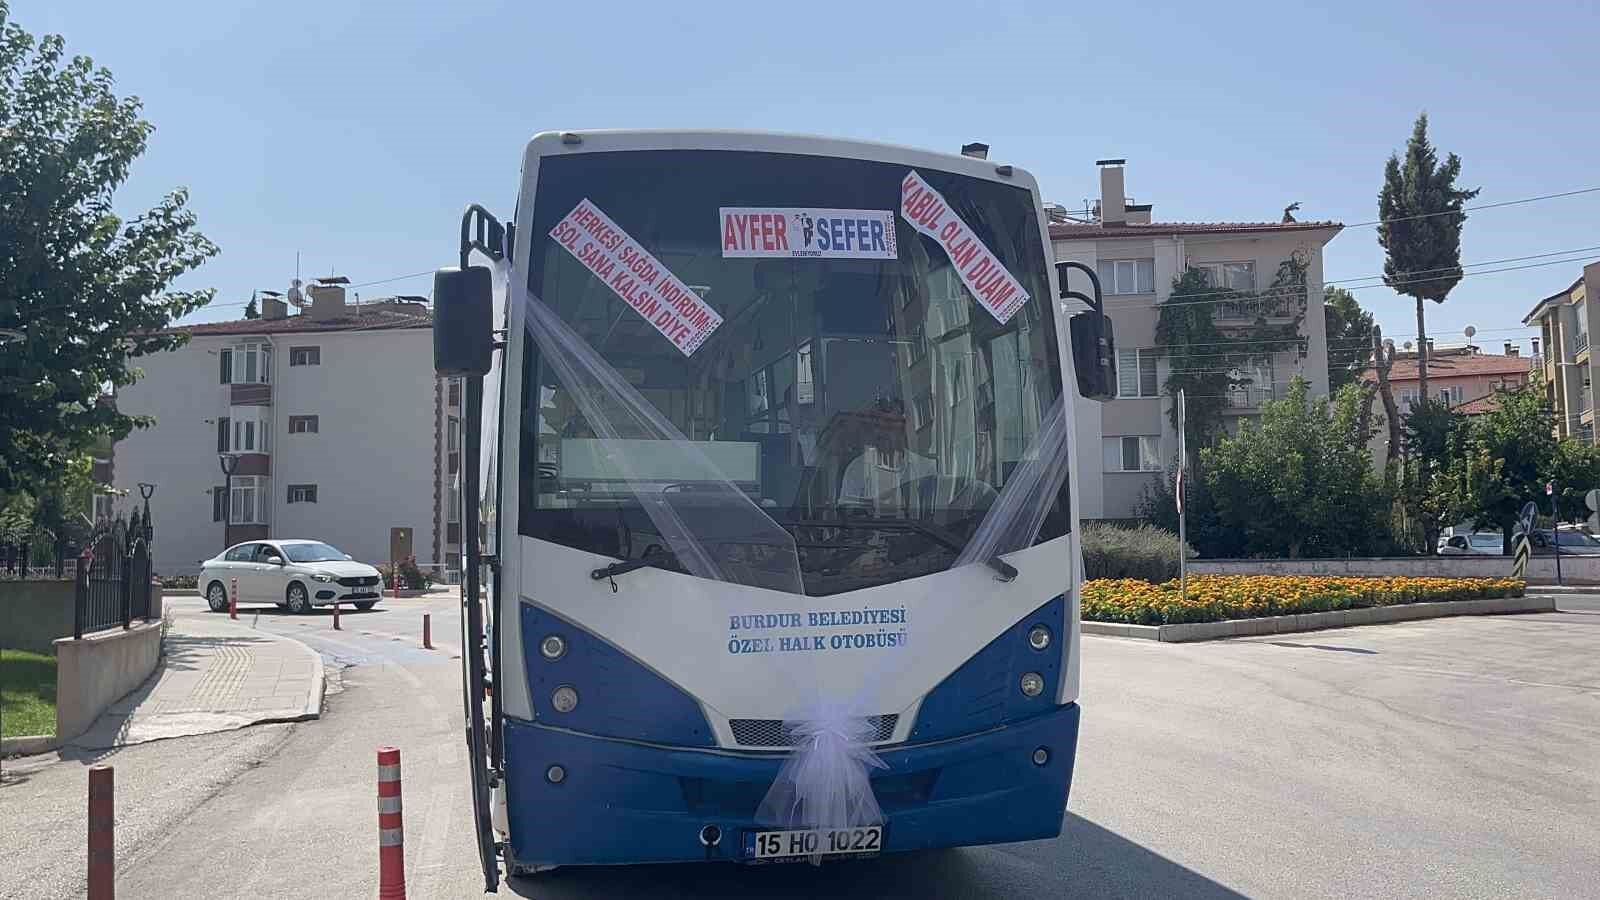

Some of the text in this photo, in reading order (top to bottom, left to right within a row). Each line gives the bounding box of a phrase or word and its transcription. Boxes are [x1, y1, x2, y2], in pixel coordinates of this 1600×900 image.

[571, 204, 628, 253] HERKESİ
[619, 246, 660, 285] SAĞDA
[724, 214, 788, 250] AYFER
[817, 217, 886, 251] SEFER
[553, 221, 581, 252] SOL
[577, 242, 615, 279] SANA
[610, 271, 660, 318] KALSIN
[656, 310, 691, 345] DİYE
[940, 221, 981, 271] OLAN
[967, 256, 1016, 310] DUAM
[729, 605, 906, 630] BURDUR BELEDİYESİ
[728, 629, 907, 654] ÖZEL HALK OTOBÜSÜ
[758, 834, 781, 855] 15
[828, 829, 880, 851] 1022
